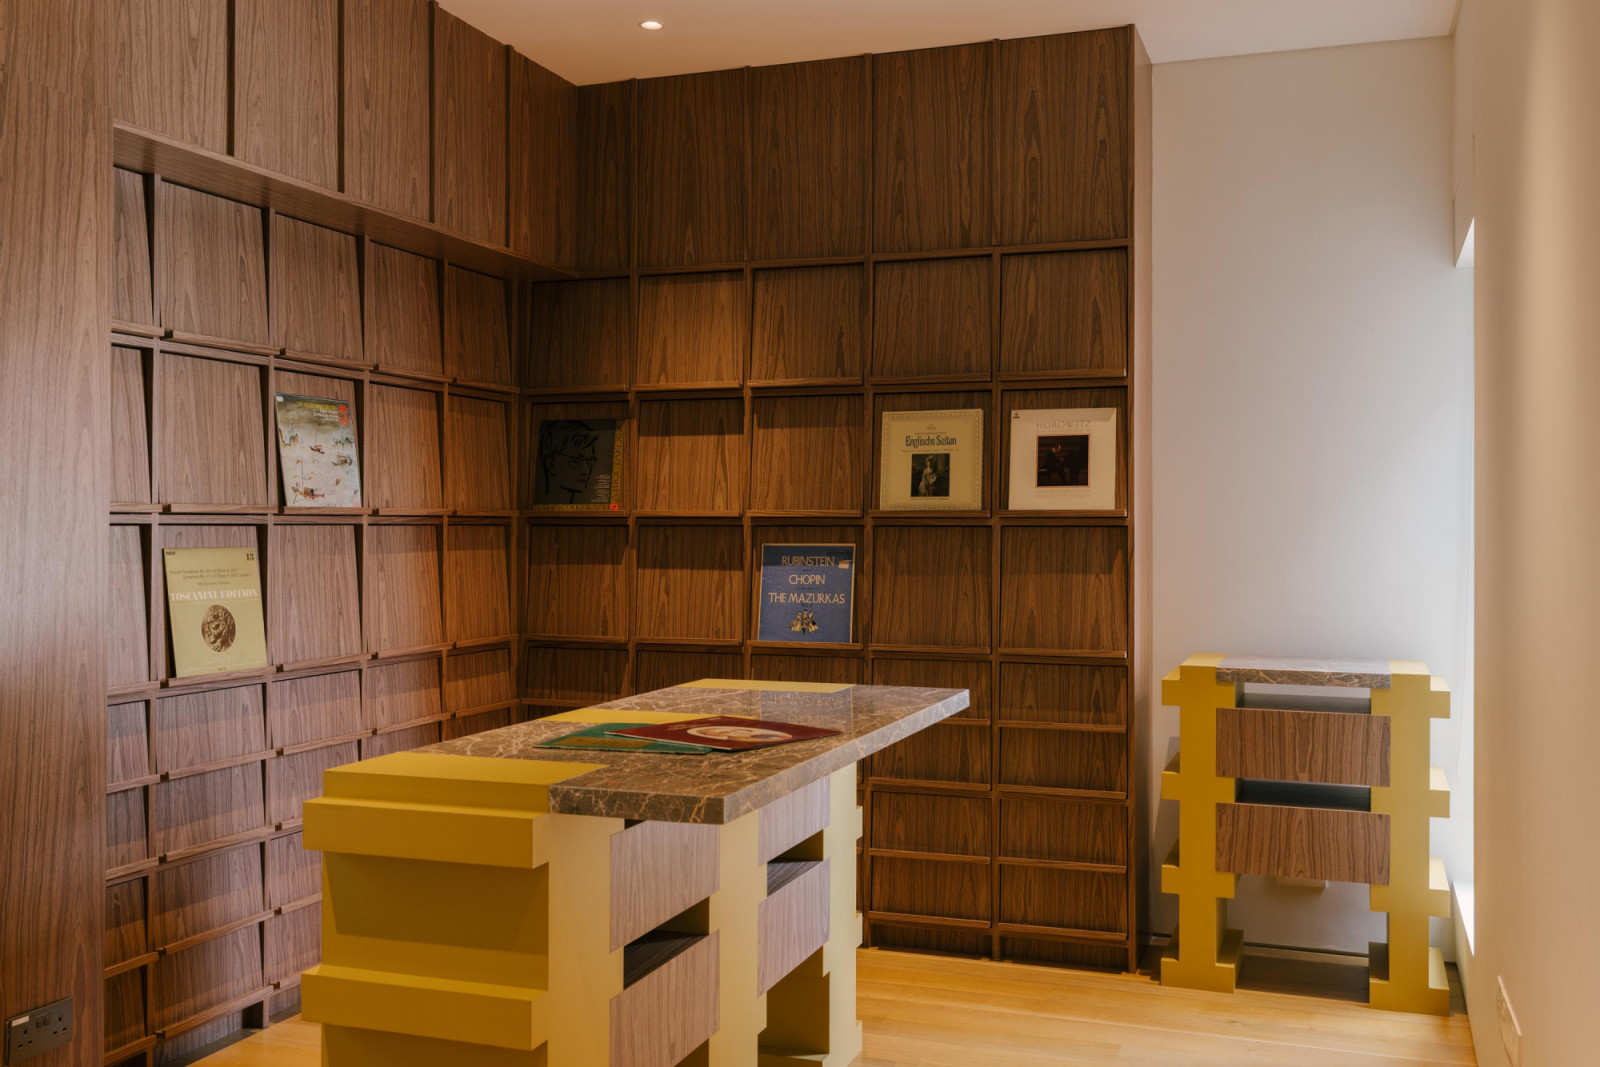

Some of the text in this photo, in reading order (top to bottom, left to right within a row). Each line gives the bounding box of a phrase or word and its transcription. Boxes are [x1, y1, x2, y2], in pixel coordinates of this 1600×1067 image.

[1036, 421, 1091, 429] HOROWITZ
[905, 435, 957, 448] Englische Suiten
[246, 553, 255, 561] 13
[781, 556, 835, 567] RUBINSTEIN
[788, 574, 826, 585] CHOPIN
[171, 589, 258, 602] TOSCANINI EDITION
[768, 592, 846, 604] THE MAZURKAS
